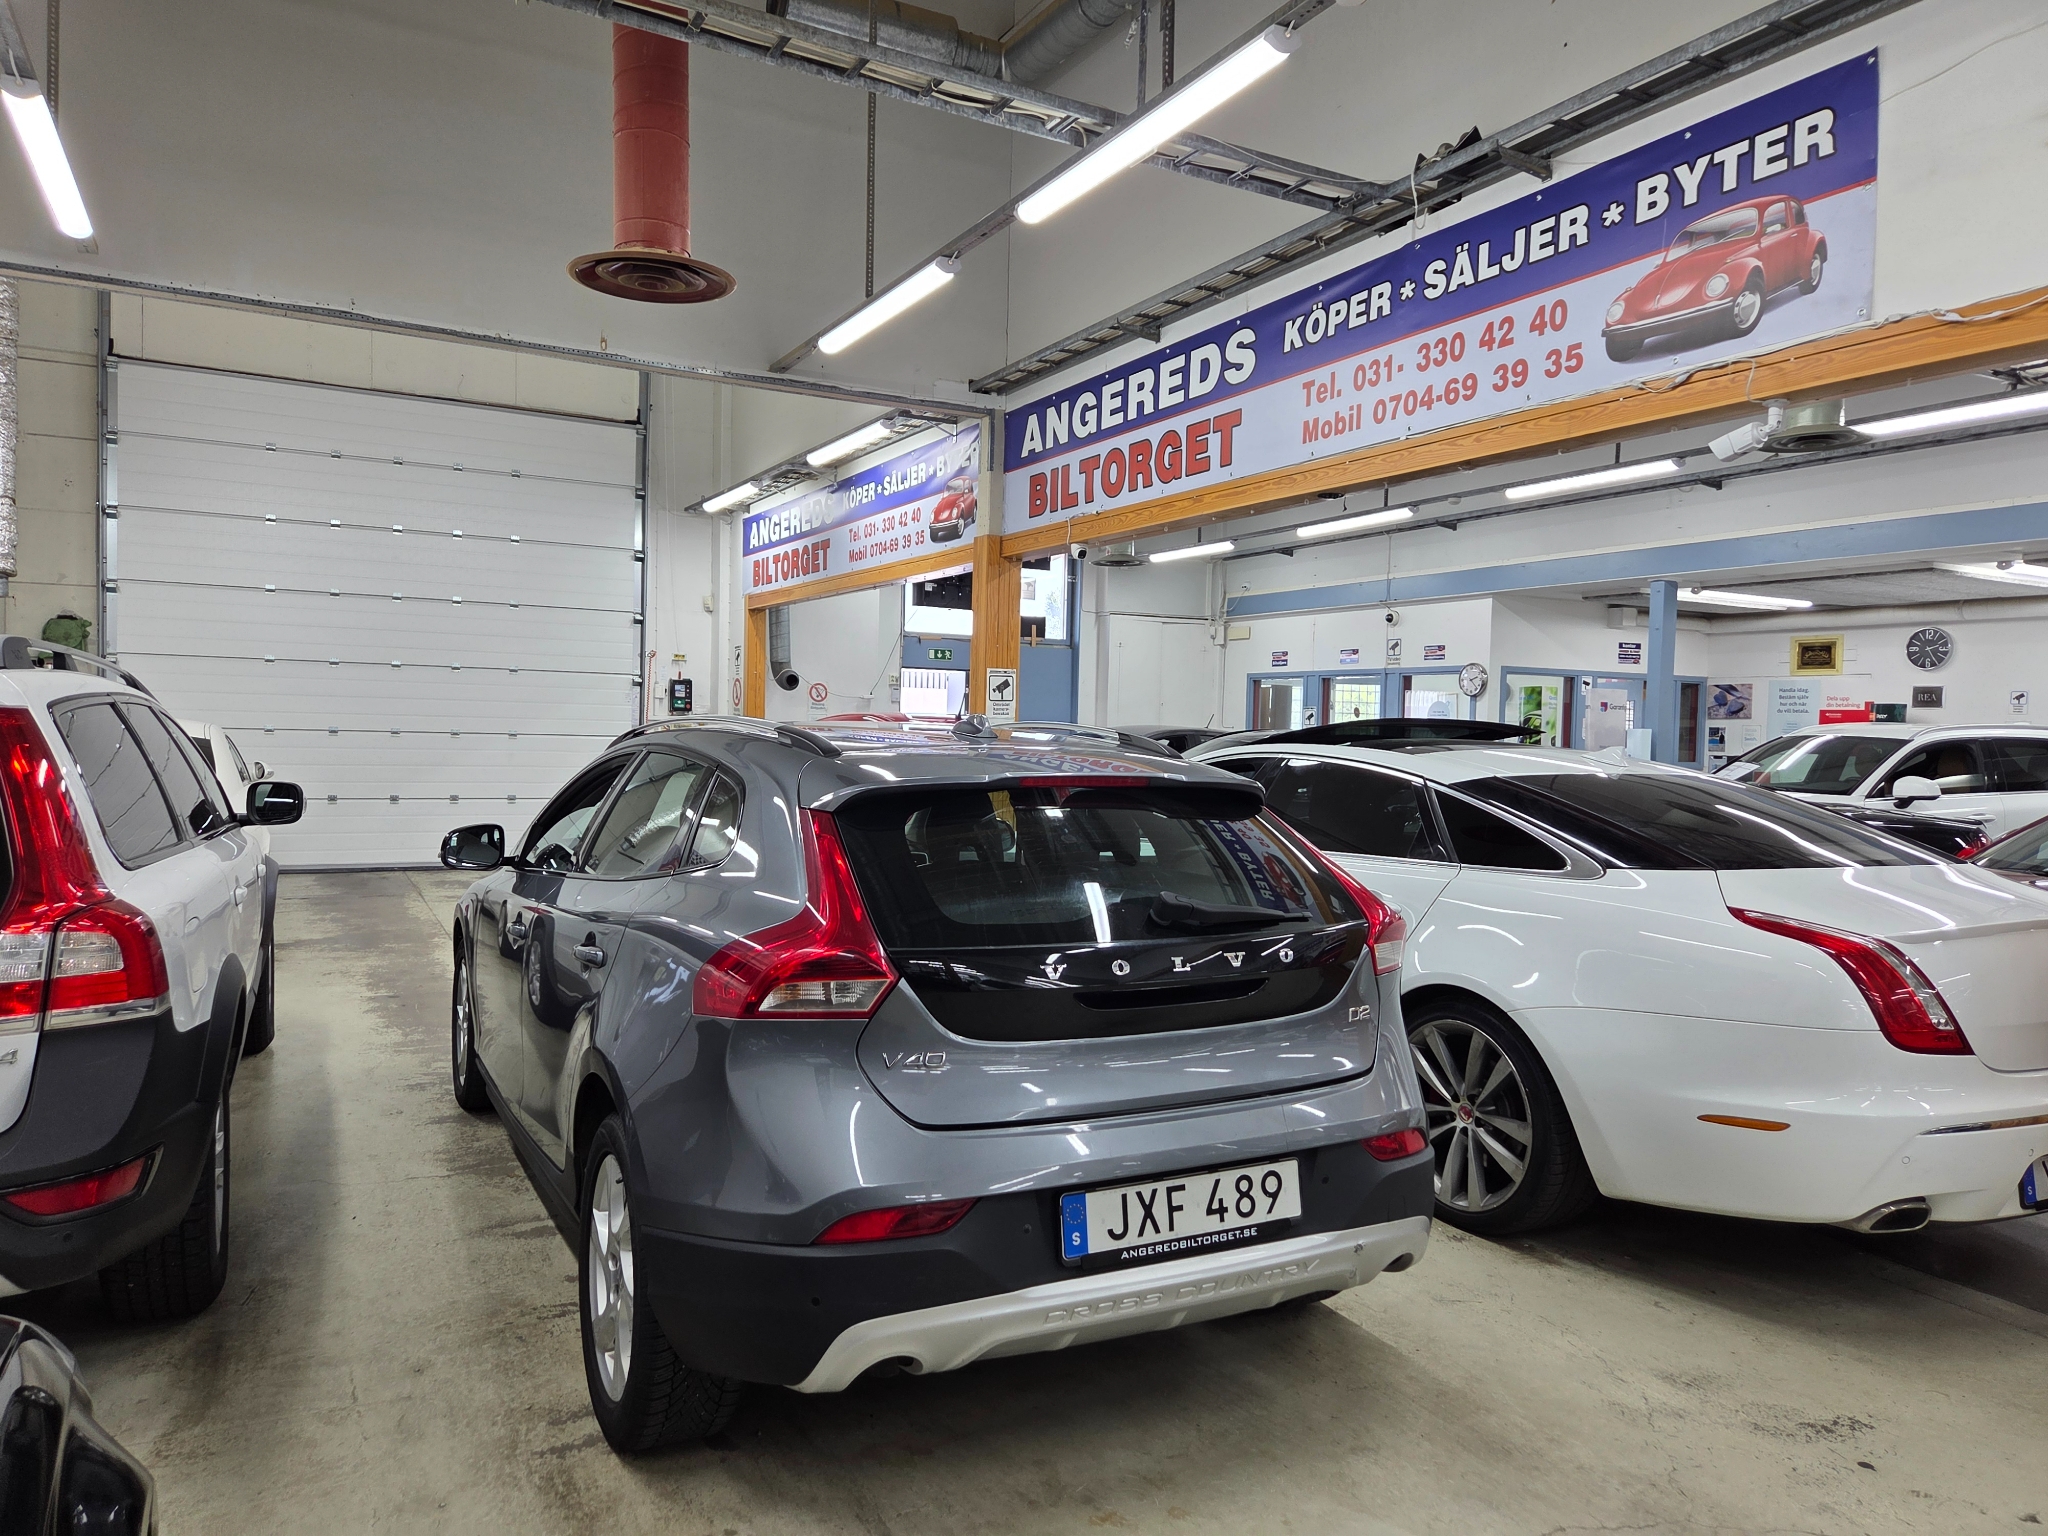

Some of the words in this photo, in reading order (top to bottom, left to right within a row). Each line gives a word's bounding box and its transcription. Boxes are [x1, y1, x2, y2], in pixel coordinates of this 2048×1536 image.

[1283, 281, 1393, 353] KÖPER
[1423, 203, 1590, 300] SÄLJER
[1635, 107, 1836, 225] BYTER
[1302, 372, 1342, 408] Tel.
[1353, 354, 1404, 391] 031-
[1416, 331, 1466, 372] 330
[1479, 315, 1514, 352] 42
[1529, 298, 1568, 336] 40
[1020, 327, 1257, 459] ANGEREDS
[1302, 404, 1362, 444] Mobil
[1373, 372, 1478, 424] 0704-69
[1492, 358, 1529, 392] 39
[1544, 342, 1584, 378] 35
[842, 481, 876, 511] KÖPER
[883, 462, 927, 496] SÄLJER
[936, 440, 980, 477] BYER
[1028, 407, 1243, 519] BILTORGET
[750, 493, 835, 549] ANGEREDS
[848, 526, 861, 543] Tel.
[864, 522, 879, 539] 031-
[882, 515, 895, 534] 330
[898, 511, 908, 528] 42
[911, 507, 922, 524] 40
[752, 538, 831, 588] BILTORGET
[848, 541, 868, 563] Mobil
[870, 537, 899, 558] 0704-69
[902, 534, 912, 549] 39
[915, 530, 925, 546] 35
[1925, 629, 1934, 639] 12
[1917, 693, 1937, 701] REA
[1040, 946, 1295, 980] VOLVO
[1348, 1004, 1371, 1023] D2
[882, 1050, 947, 1069] V40
[1072, 1231, 1081, 1246] S
[1107, 1183, 1187, 1241] JXF
[1205, 1169, 1284, 1223] 489
[2027, 1185, 2033, 1196] S
[1120, 1226, 1259, 1260] ANGEREDBILTORGET.SE
[1043, 1291, 1165, 1326] CROSS
[1175, 1258, 1320, 1301] COUNTRY
